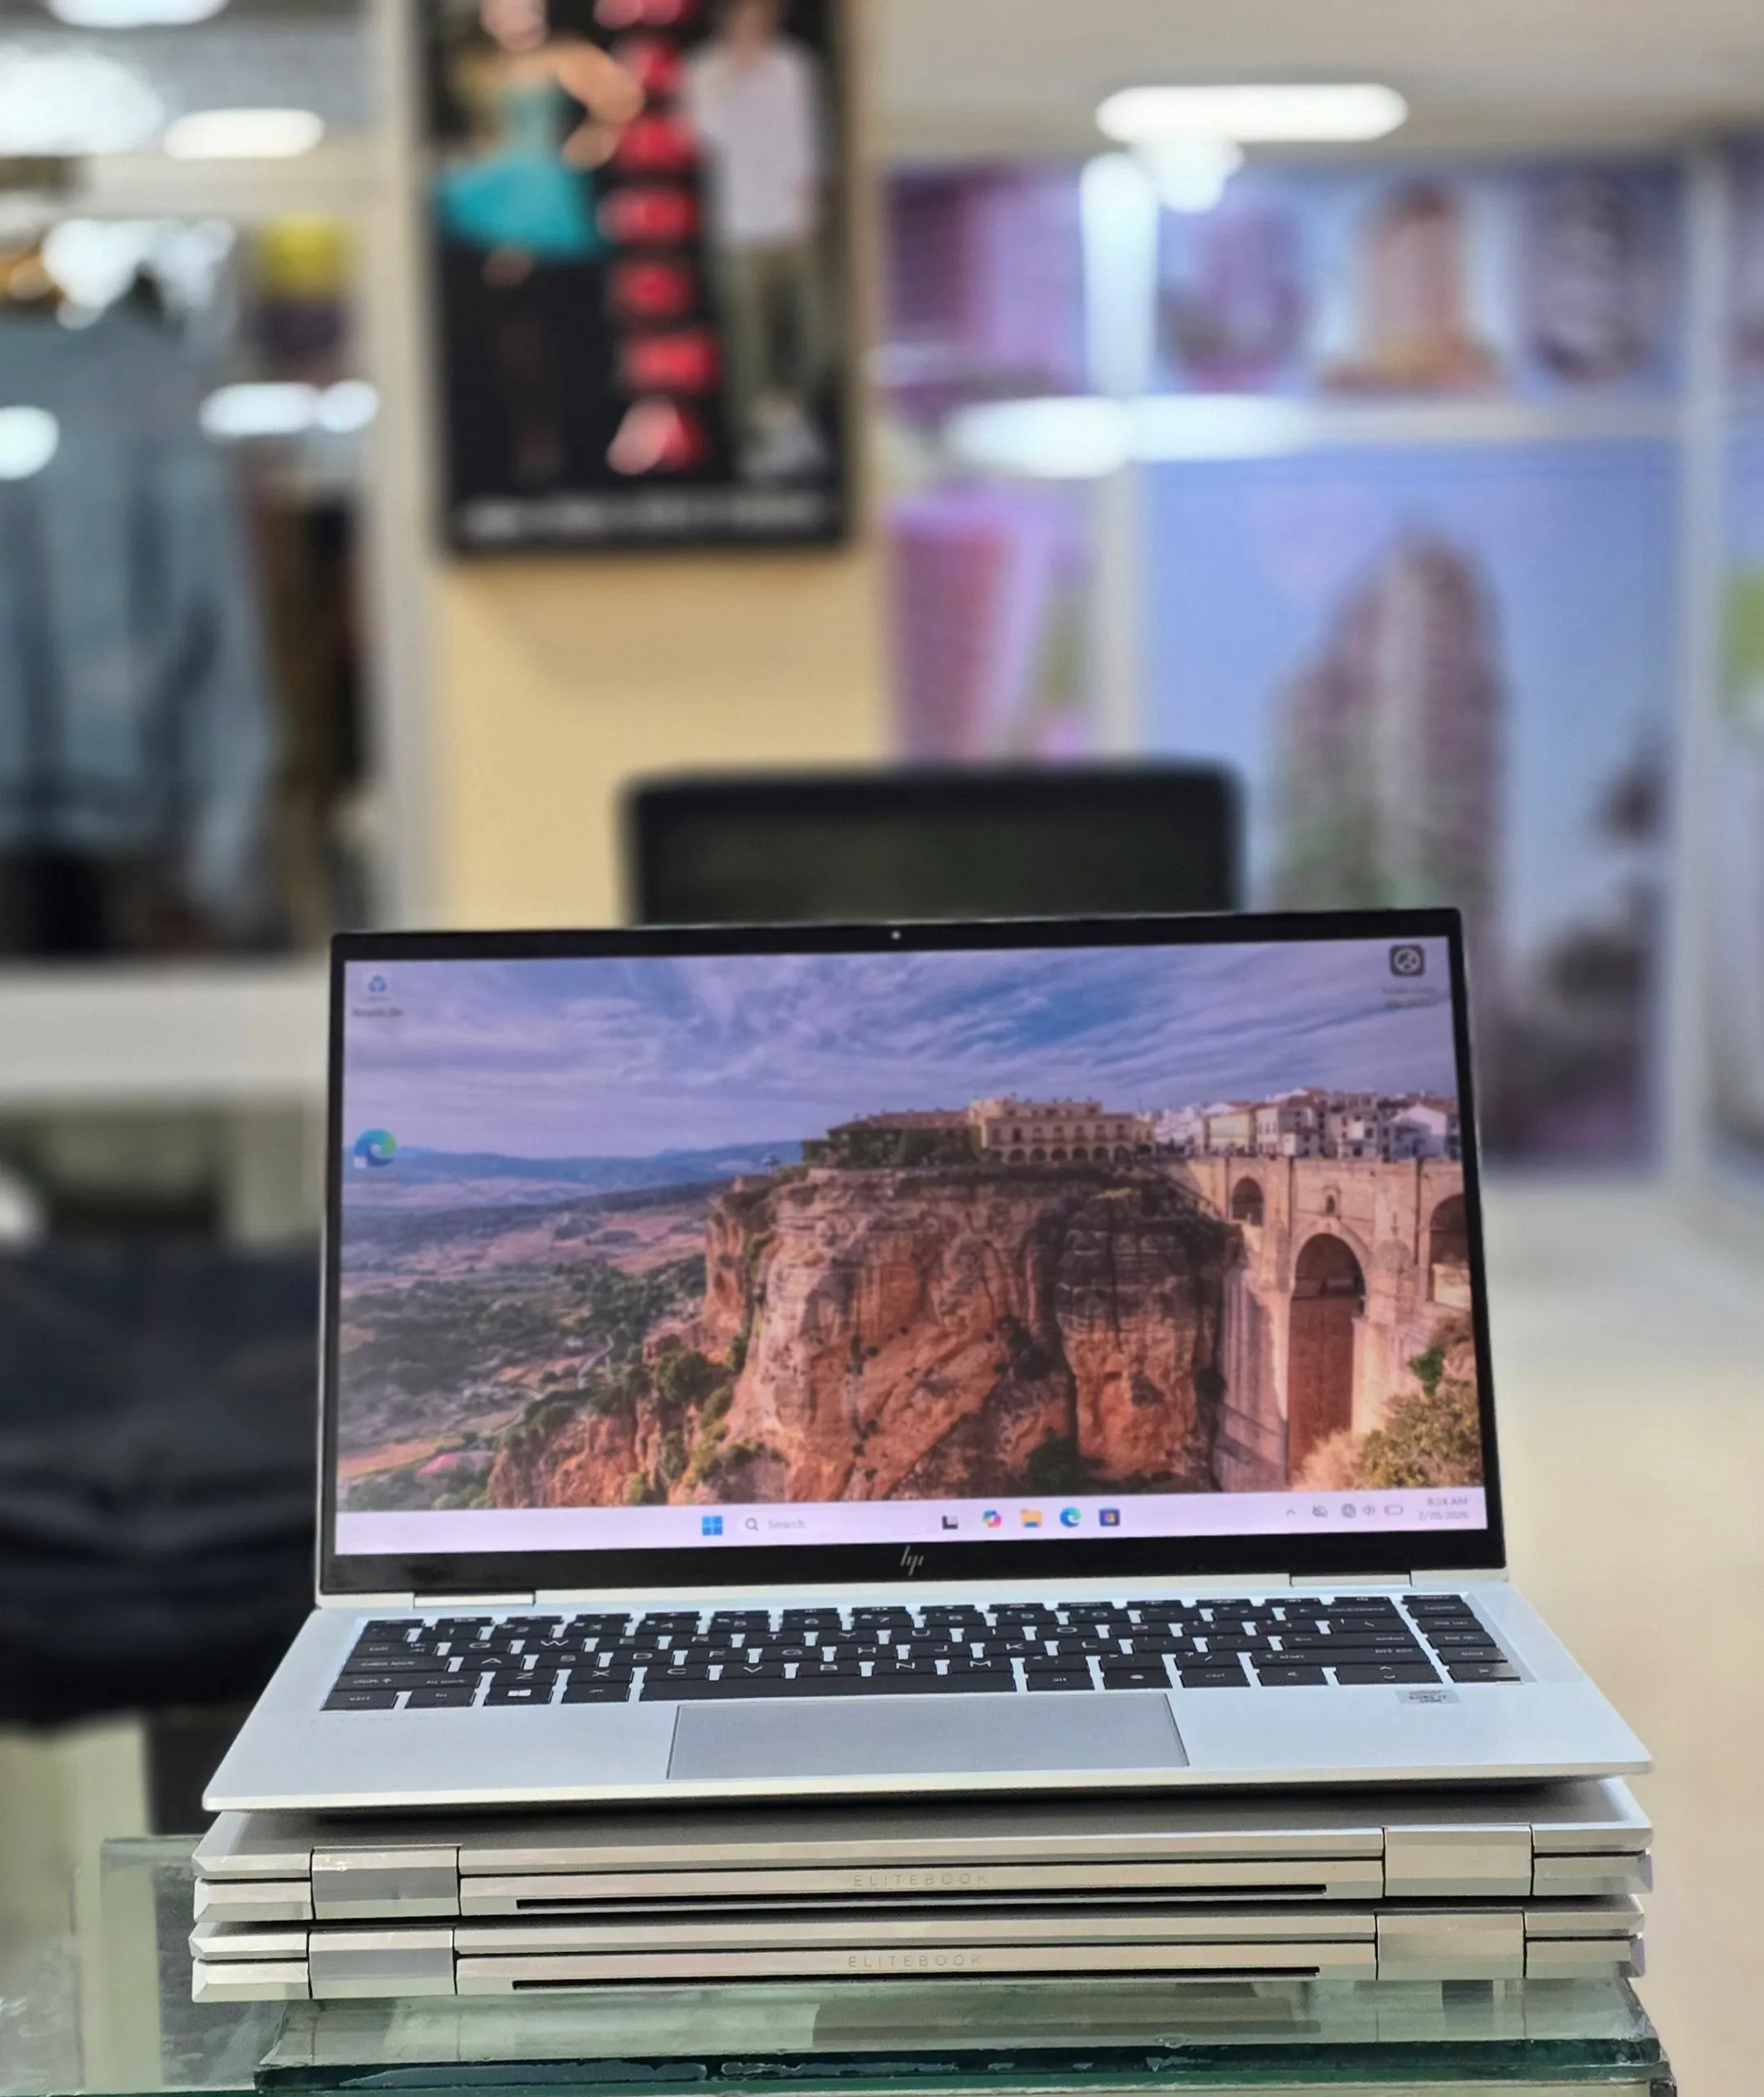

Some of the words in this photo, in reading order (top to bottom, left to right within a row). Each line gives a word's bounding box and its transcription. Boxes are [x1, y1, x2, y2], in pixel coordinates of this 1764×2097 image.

[767, 1518, 805, 1529] Search
[857, 1646, 877, 1655] H
[1006, 1642, 1024, 1651] K
[895, 1661, 916, 1670] N
[969, 1660, 992, 1668] M
[591, 1669, 611, 1678] X
[743, 1665, 763, 1674] V
[853, 1873, 988, 1886] ELITEBOOK
[848, 1953, 984, 1968] ELITEBOOK
